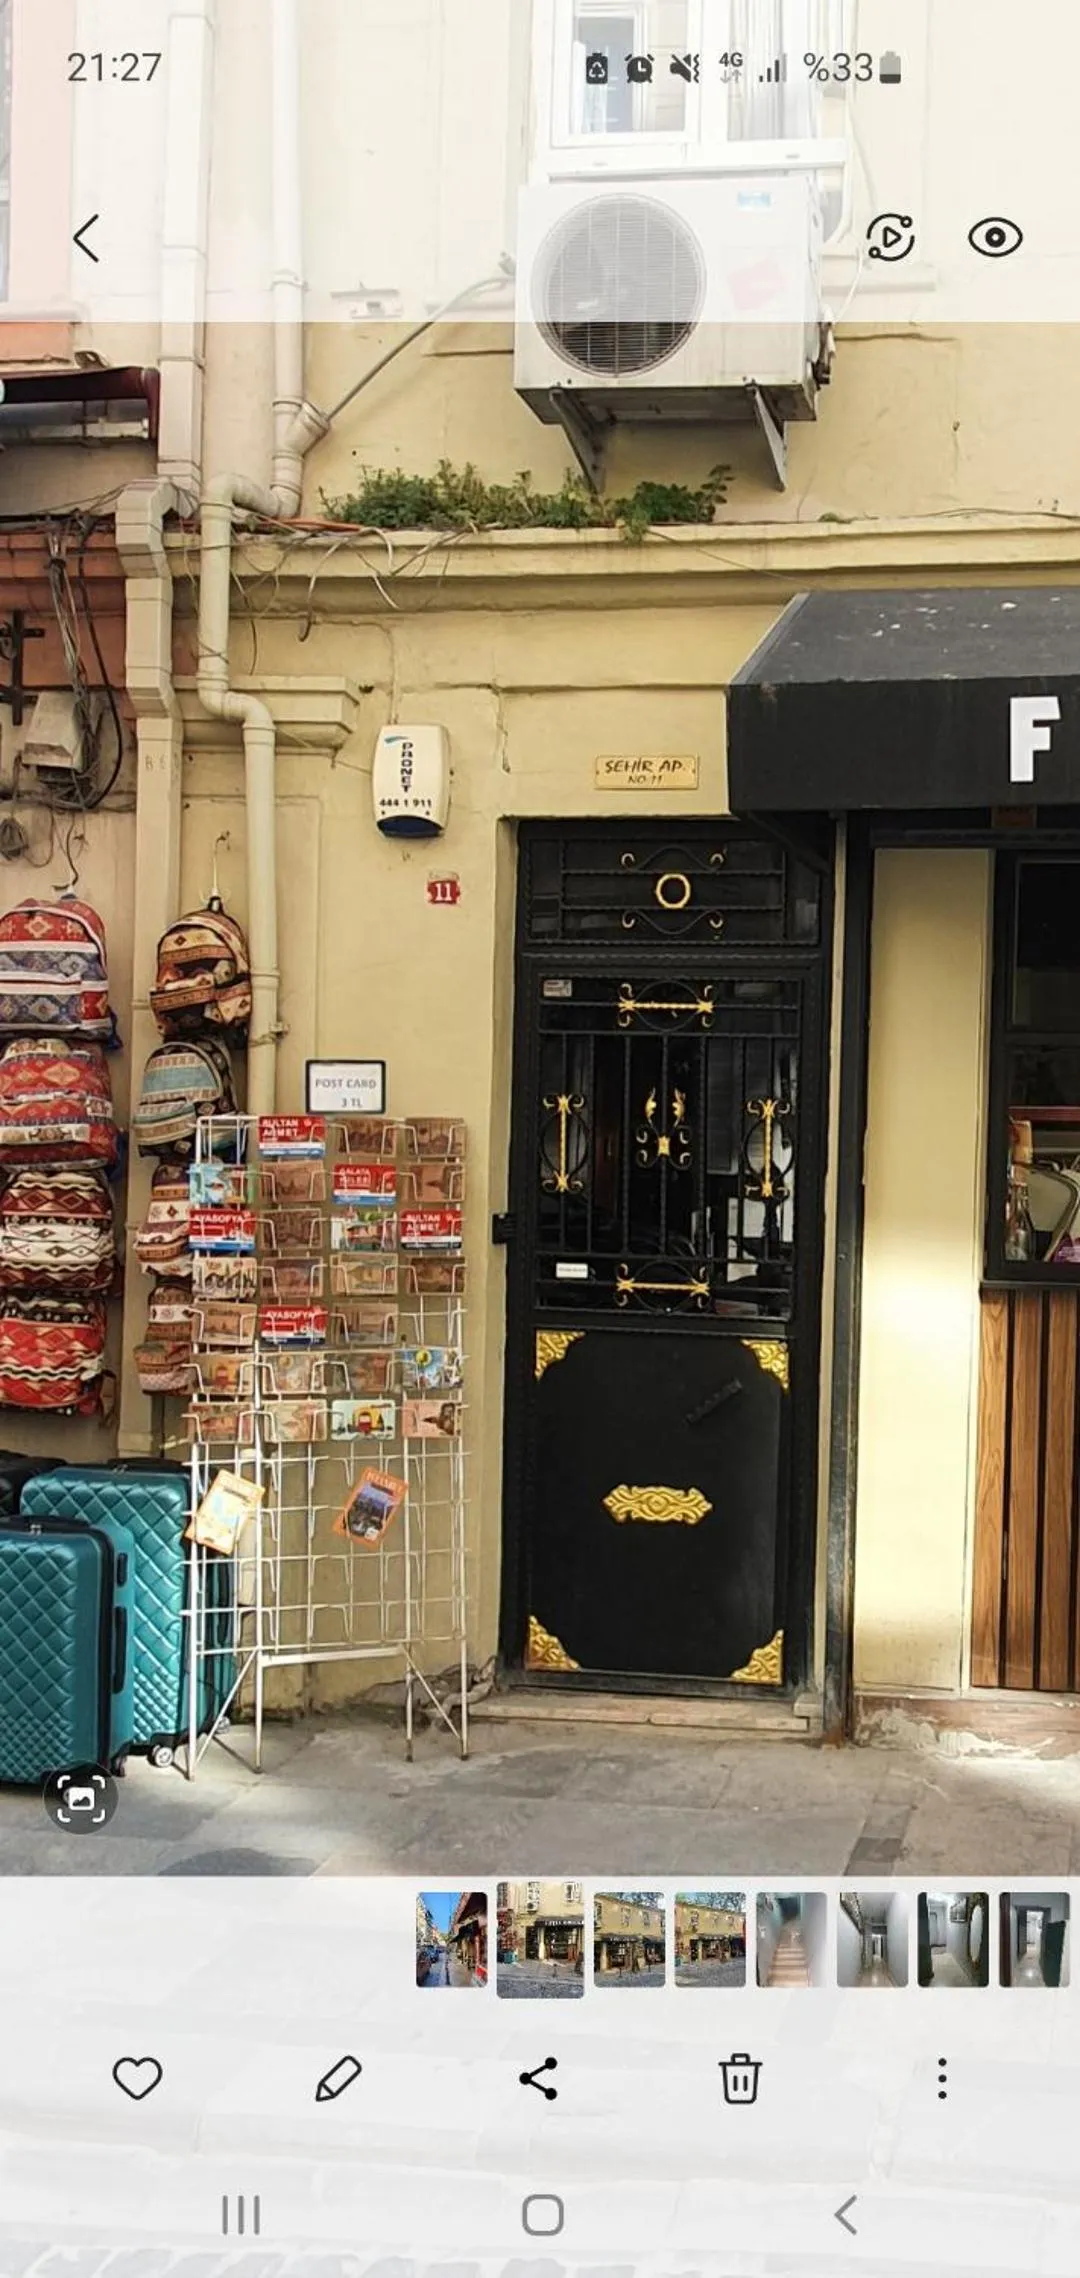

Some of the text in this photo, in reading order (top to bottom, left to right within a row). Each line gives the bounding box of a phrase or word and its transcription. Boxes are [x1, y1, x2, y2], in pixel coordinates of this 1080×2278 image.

[1009, 696, 1061, 783] F
[379, 798, 400, 808] 444
[413, 798, 433, 808] 911
[435, 883, 452, 901] 11
[315, 1078, 377, 1089] POST CARD
[341, 1097, 363, 1108] 3 TL
